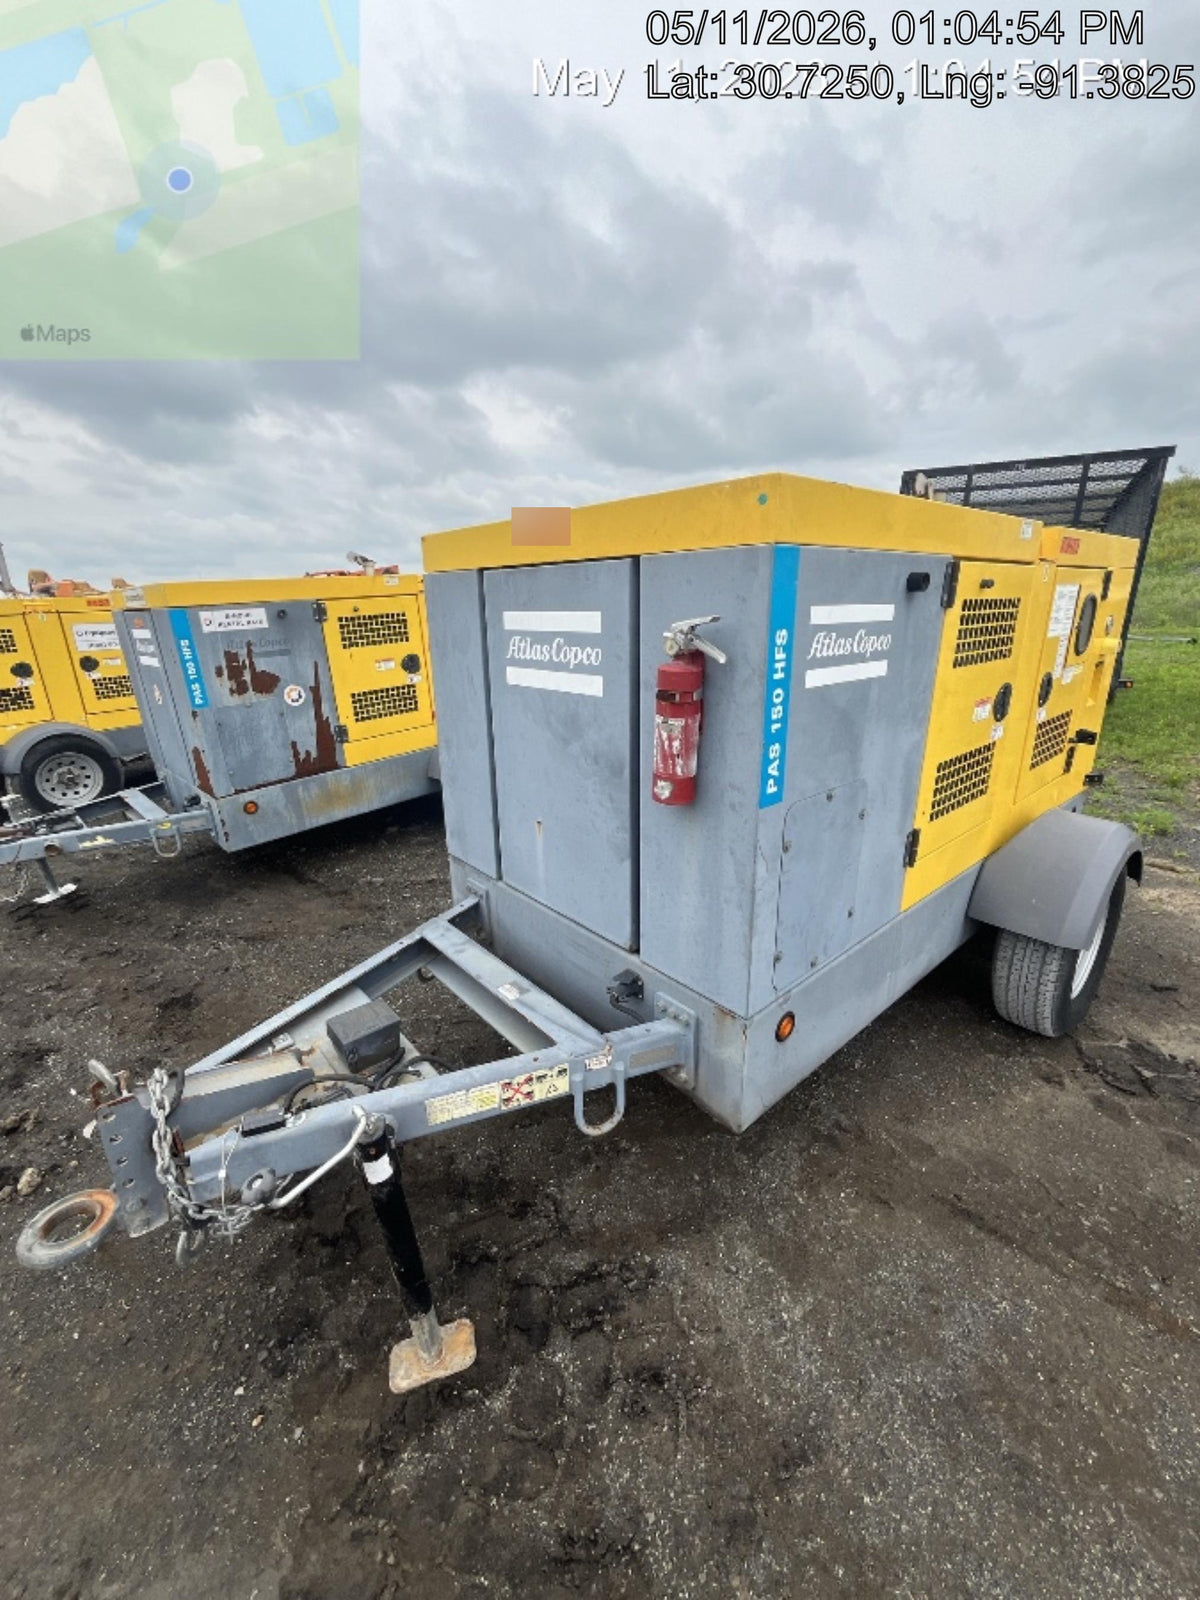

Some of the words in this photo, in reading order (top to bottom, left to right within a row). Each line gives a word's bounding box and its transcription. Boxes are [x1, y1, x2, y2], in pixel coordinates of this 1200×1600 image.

[773, 628, 789, 680] HFS
[771, 687, 785, 733] 150
[766, 743, 780, 794] PAS
